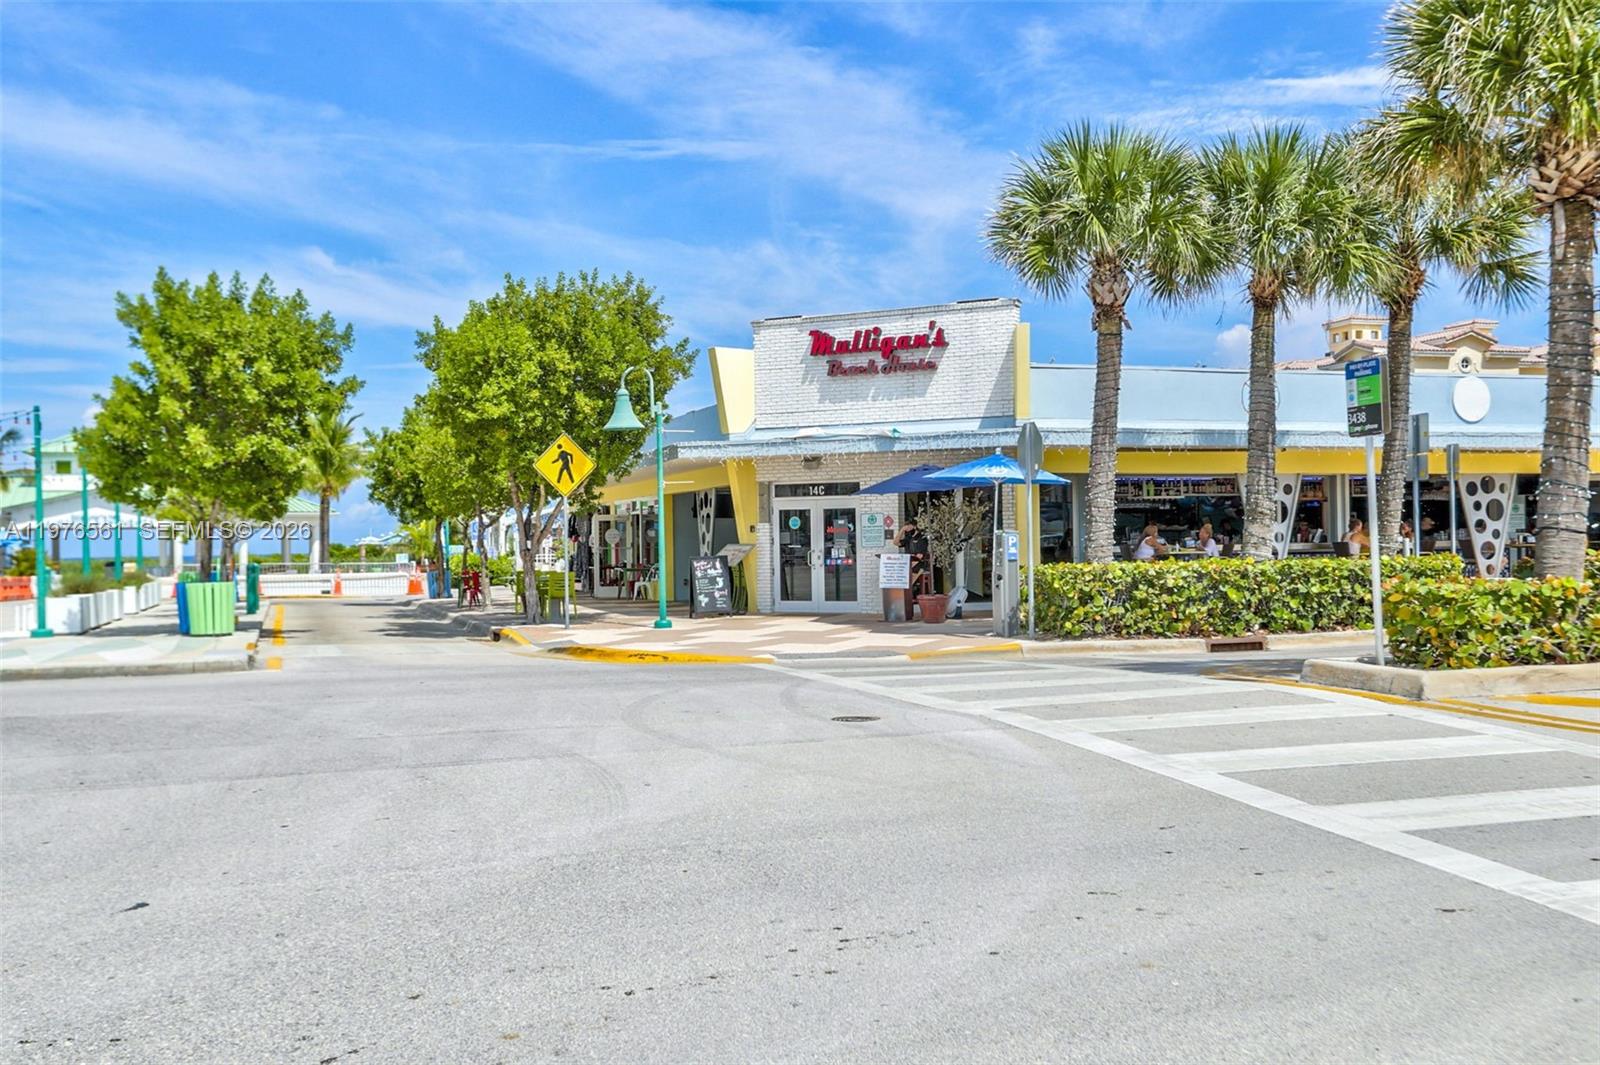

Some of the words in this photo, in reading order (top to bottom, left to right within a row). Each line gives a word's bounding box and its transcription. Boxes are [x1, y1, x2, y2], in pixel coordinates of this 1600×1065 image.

[808, 320, 949, 360] Mulligan's
[1348, 411, 1367, 425] 3438
[809, 485, 825, 496] 14C
[1008, 535, 1017, 547] P
